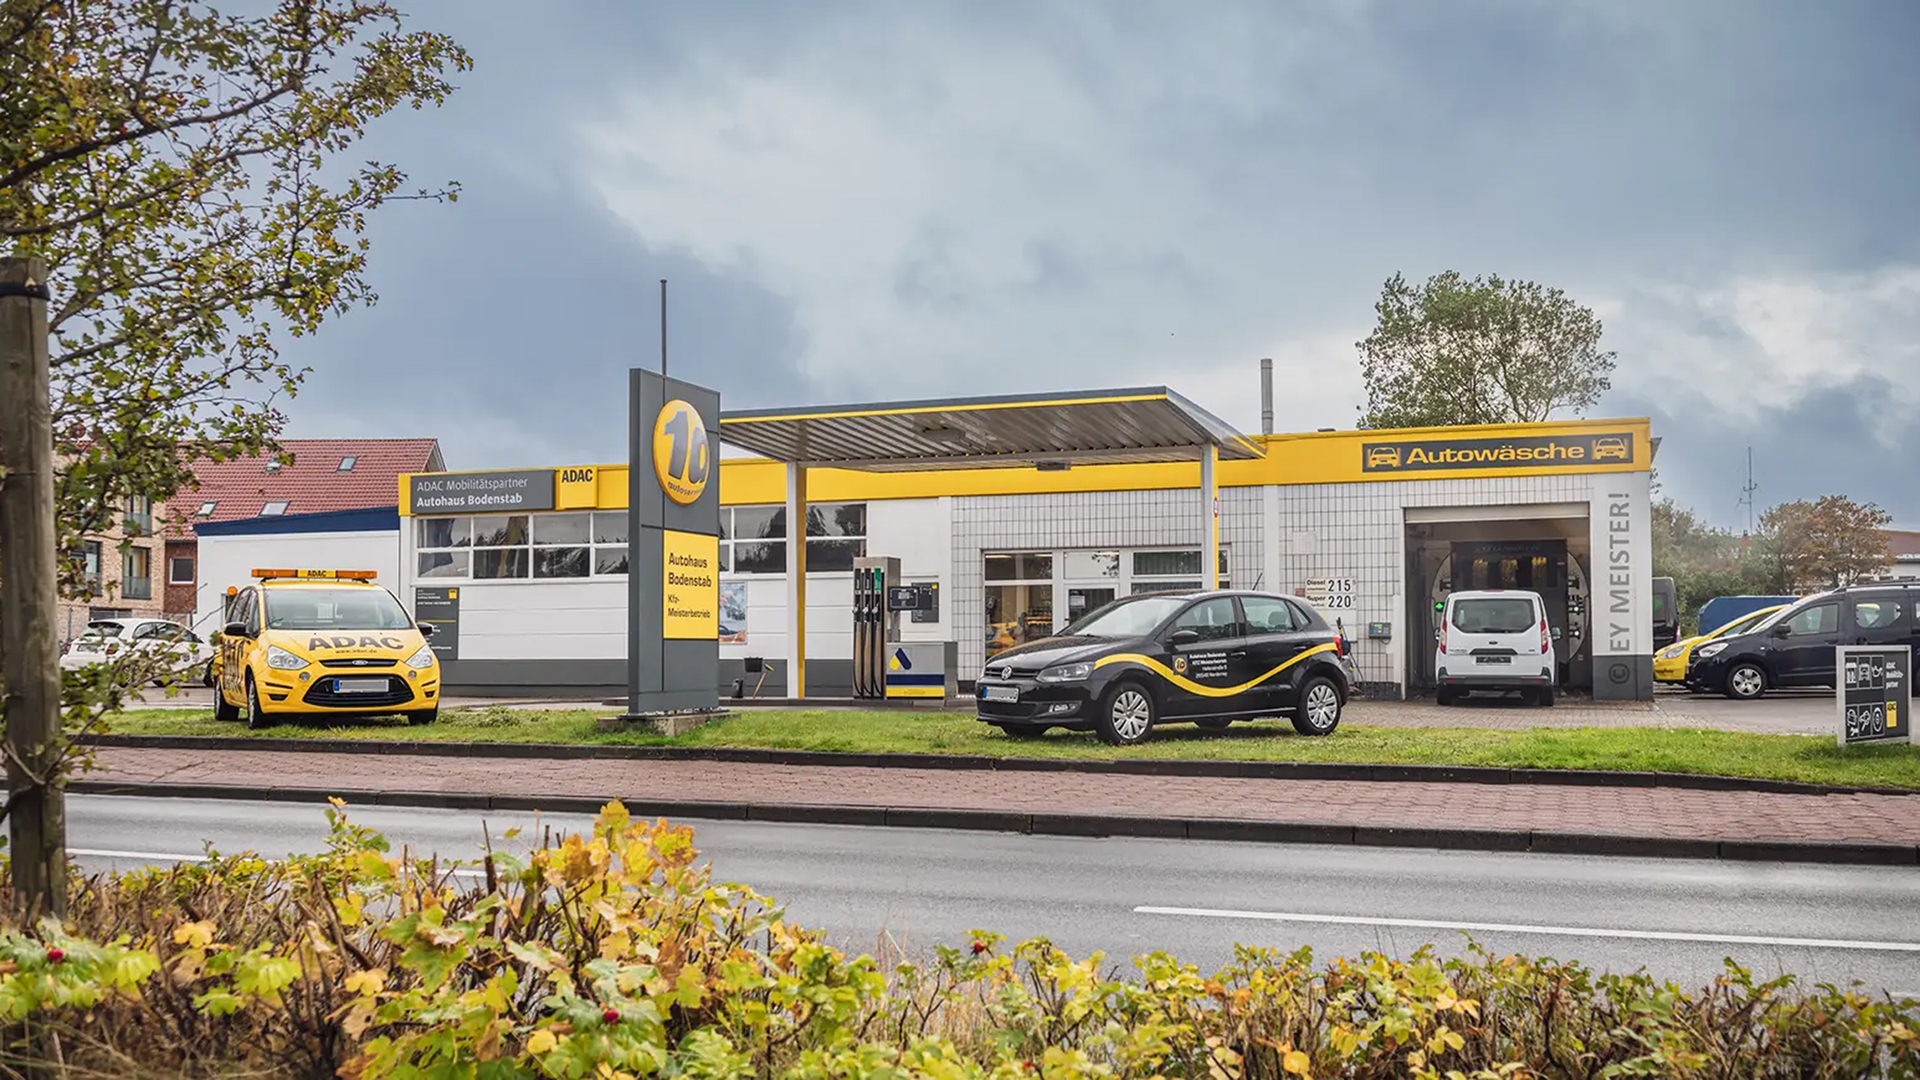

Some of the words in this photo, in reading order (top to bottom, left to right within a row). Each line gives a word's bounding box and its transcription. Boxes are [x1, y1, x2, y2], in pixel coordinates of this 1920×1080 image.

[1406, 442, 1585, 465] Autowäsche
[561, 468, 593, 483] ADAC
[416, 481, 444, 492] ADAC
[446, 478, 529, 492] Mobilitätspartner
[416, 496, 465, 507] Autohaus
[467, 493, 522, 505] Bodenstab
[668, 552, 708, 568] Autohaus
[1608, 493, 1630, 613] MEISTER!
[307, 570, 327, 578] ADAC
[668, 572, 712, 587] Bodenstab
[1328, 579, 1351, 592] 215
[1328, 595, 1351, 608] 220
[667, 608, 711, 618] Meisterbetrieb
[308, 636, 404, 651] ADAC
[1609, 623, 1630, 651] EY
